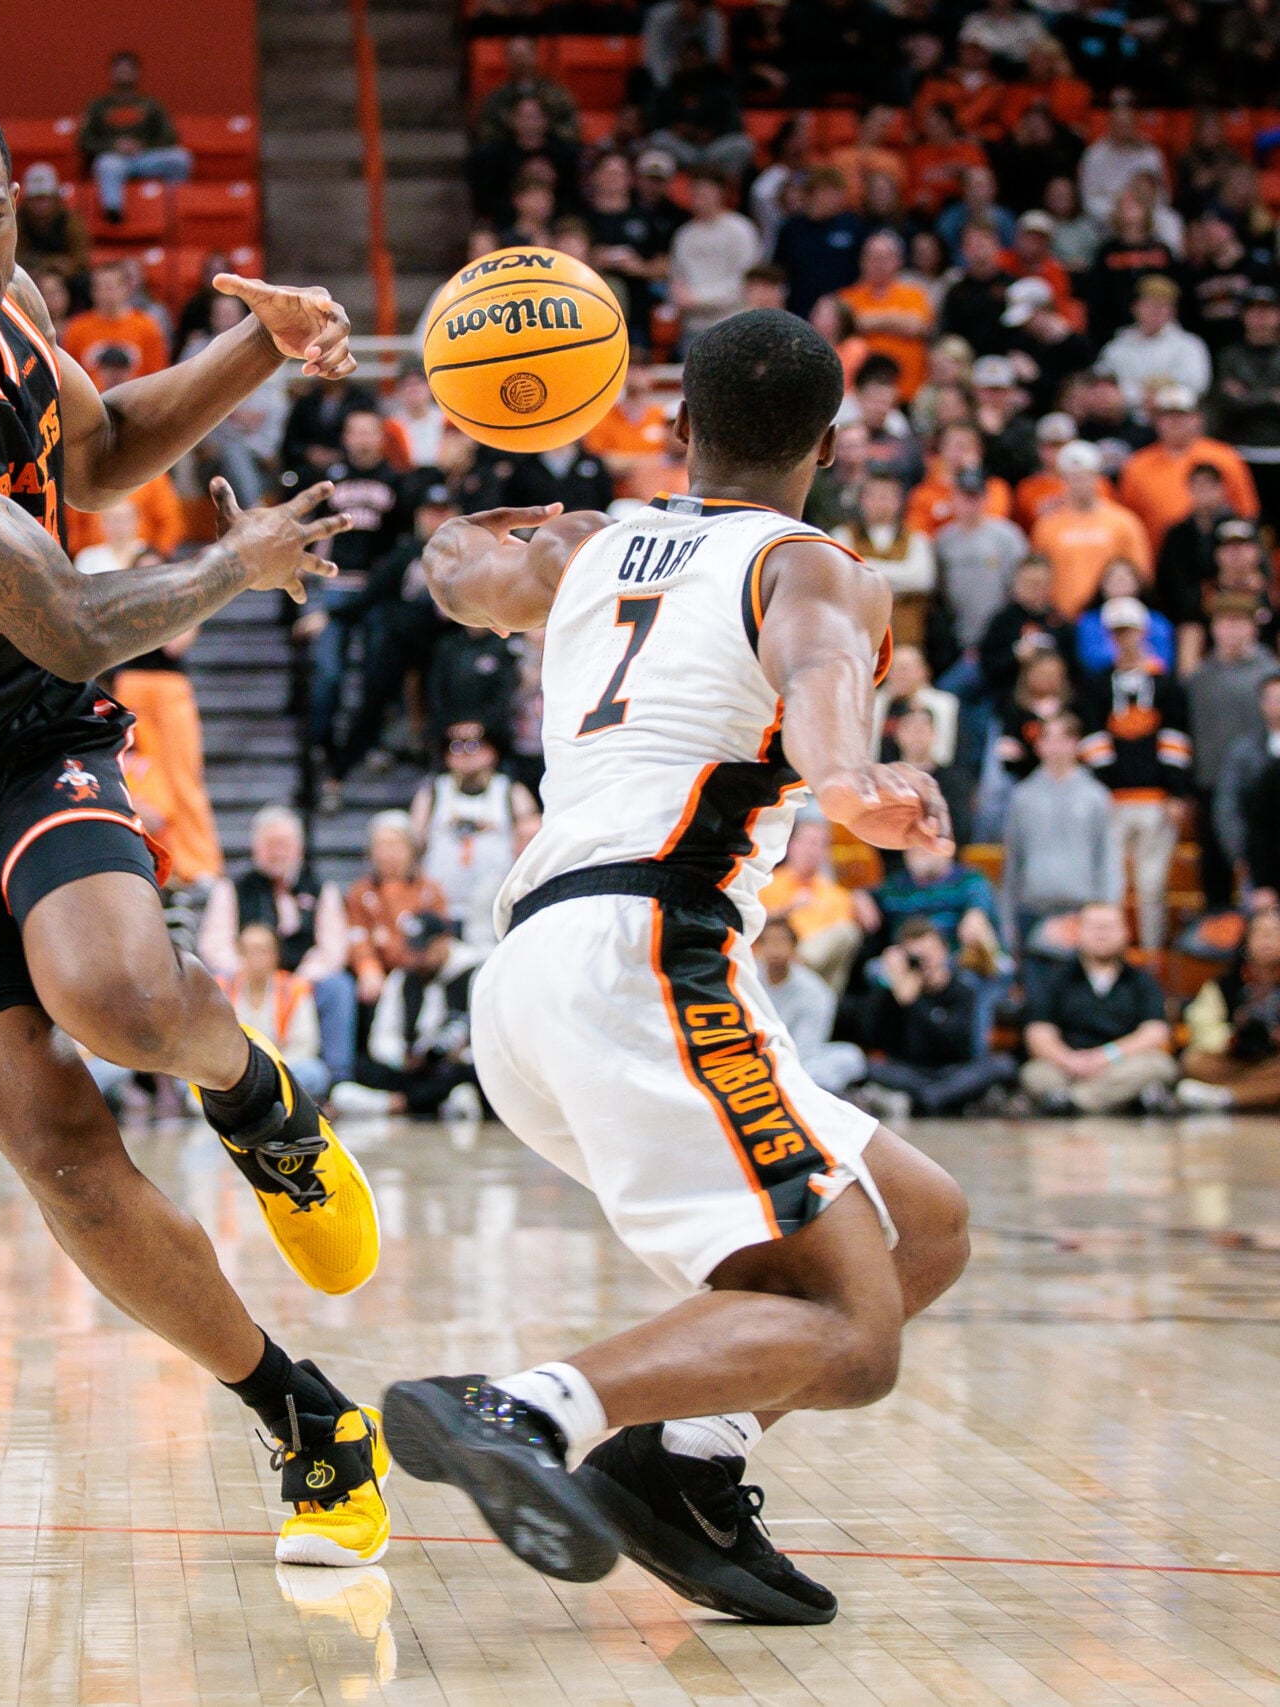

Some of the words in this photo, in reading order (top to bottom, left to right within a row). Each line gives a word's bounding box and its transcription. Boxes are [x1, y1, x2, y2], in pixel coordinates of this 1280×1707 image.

[460, 254, 555, 286] NCAA
[445, 297, 583, 341] Wilson
[618, 534, 708, 583] CLARY
[684, 1002, 806, 1166] COWBOYS
